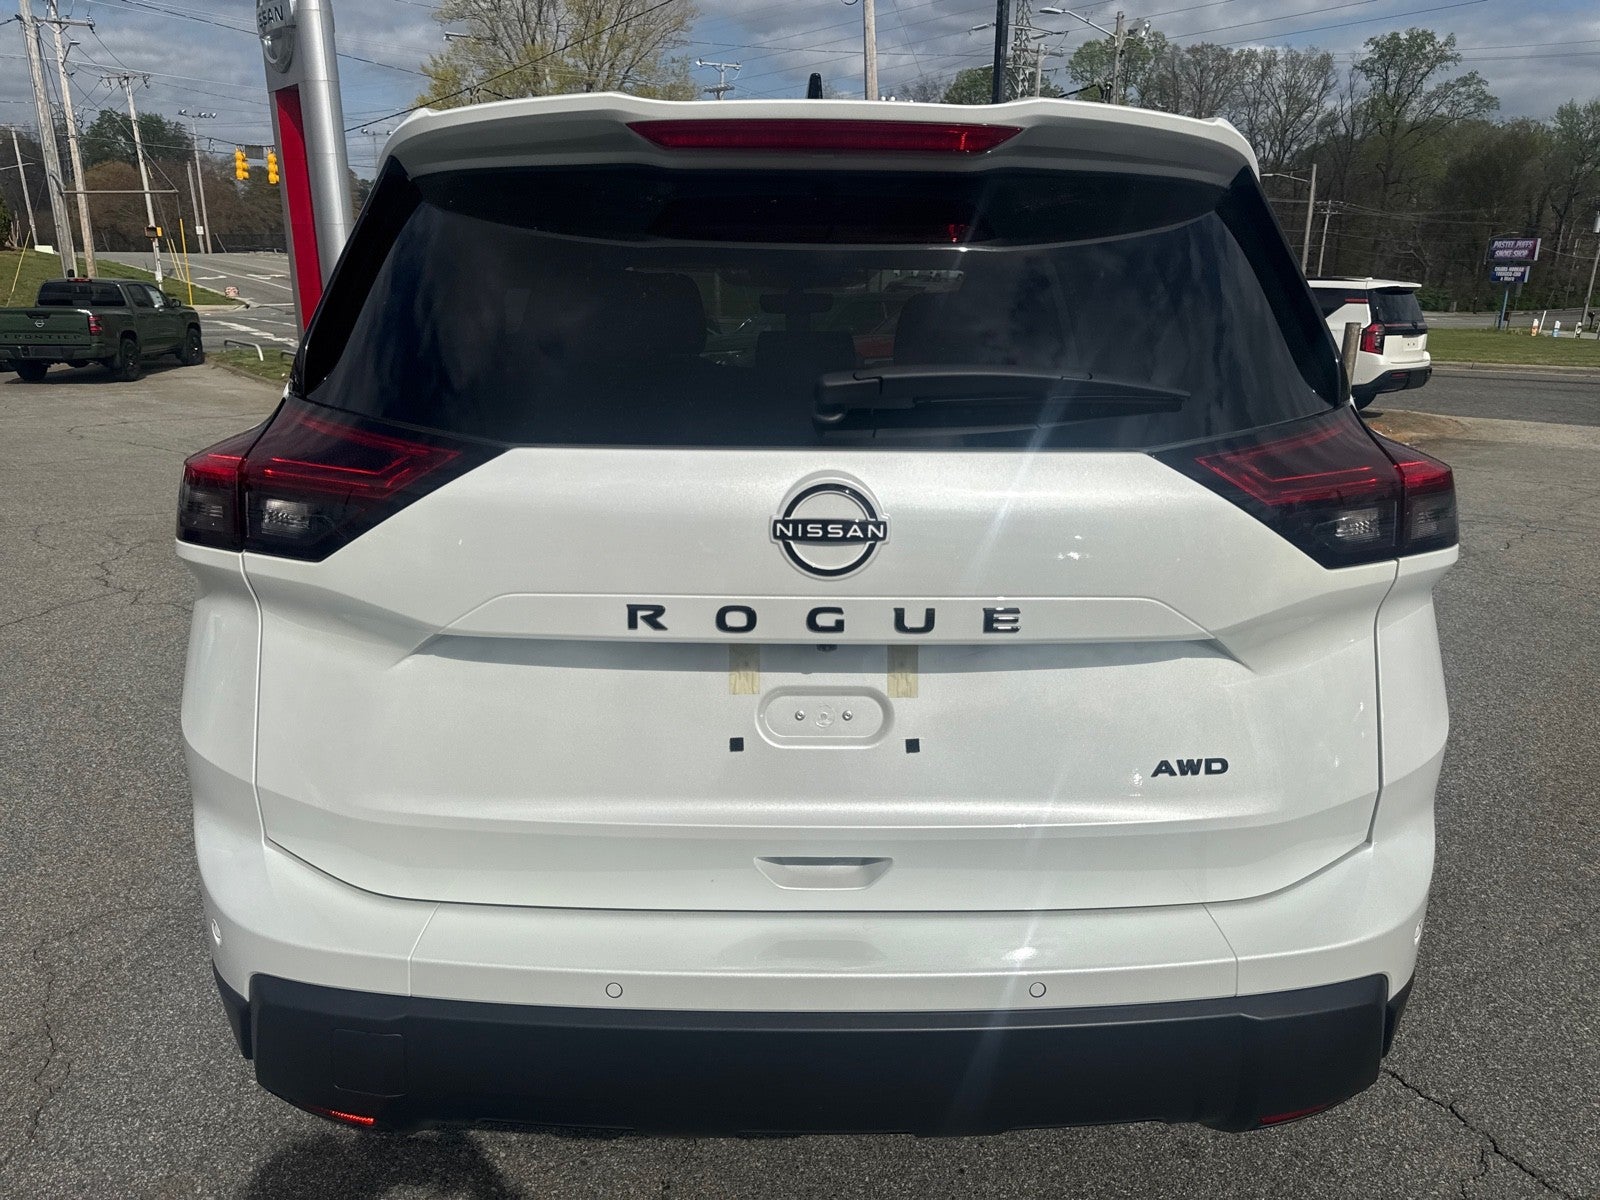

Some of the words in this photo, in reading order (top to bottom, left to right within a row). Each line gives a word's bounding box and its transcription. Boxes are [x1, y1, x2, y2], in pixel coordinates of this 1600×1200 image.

[776, 523, 884, 538] NISSAN
[626, 604, 1022, 634] ROGUE
[1150, 757, 1229, 778] AWD
